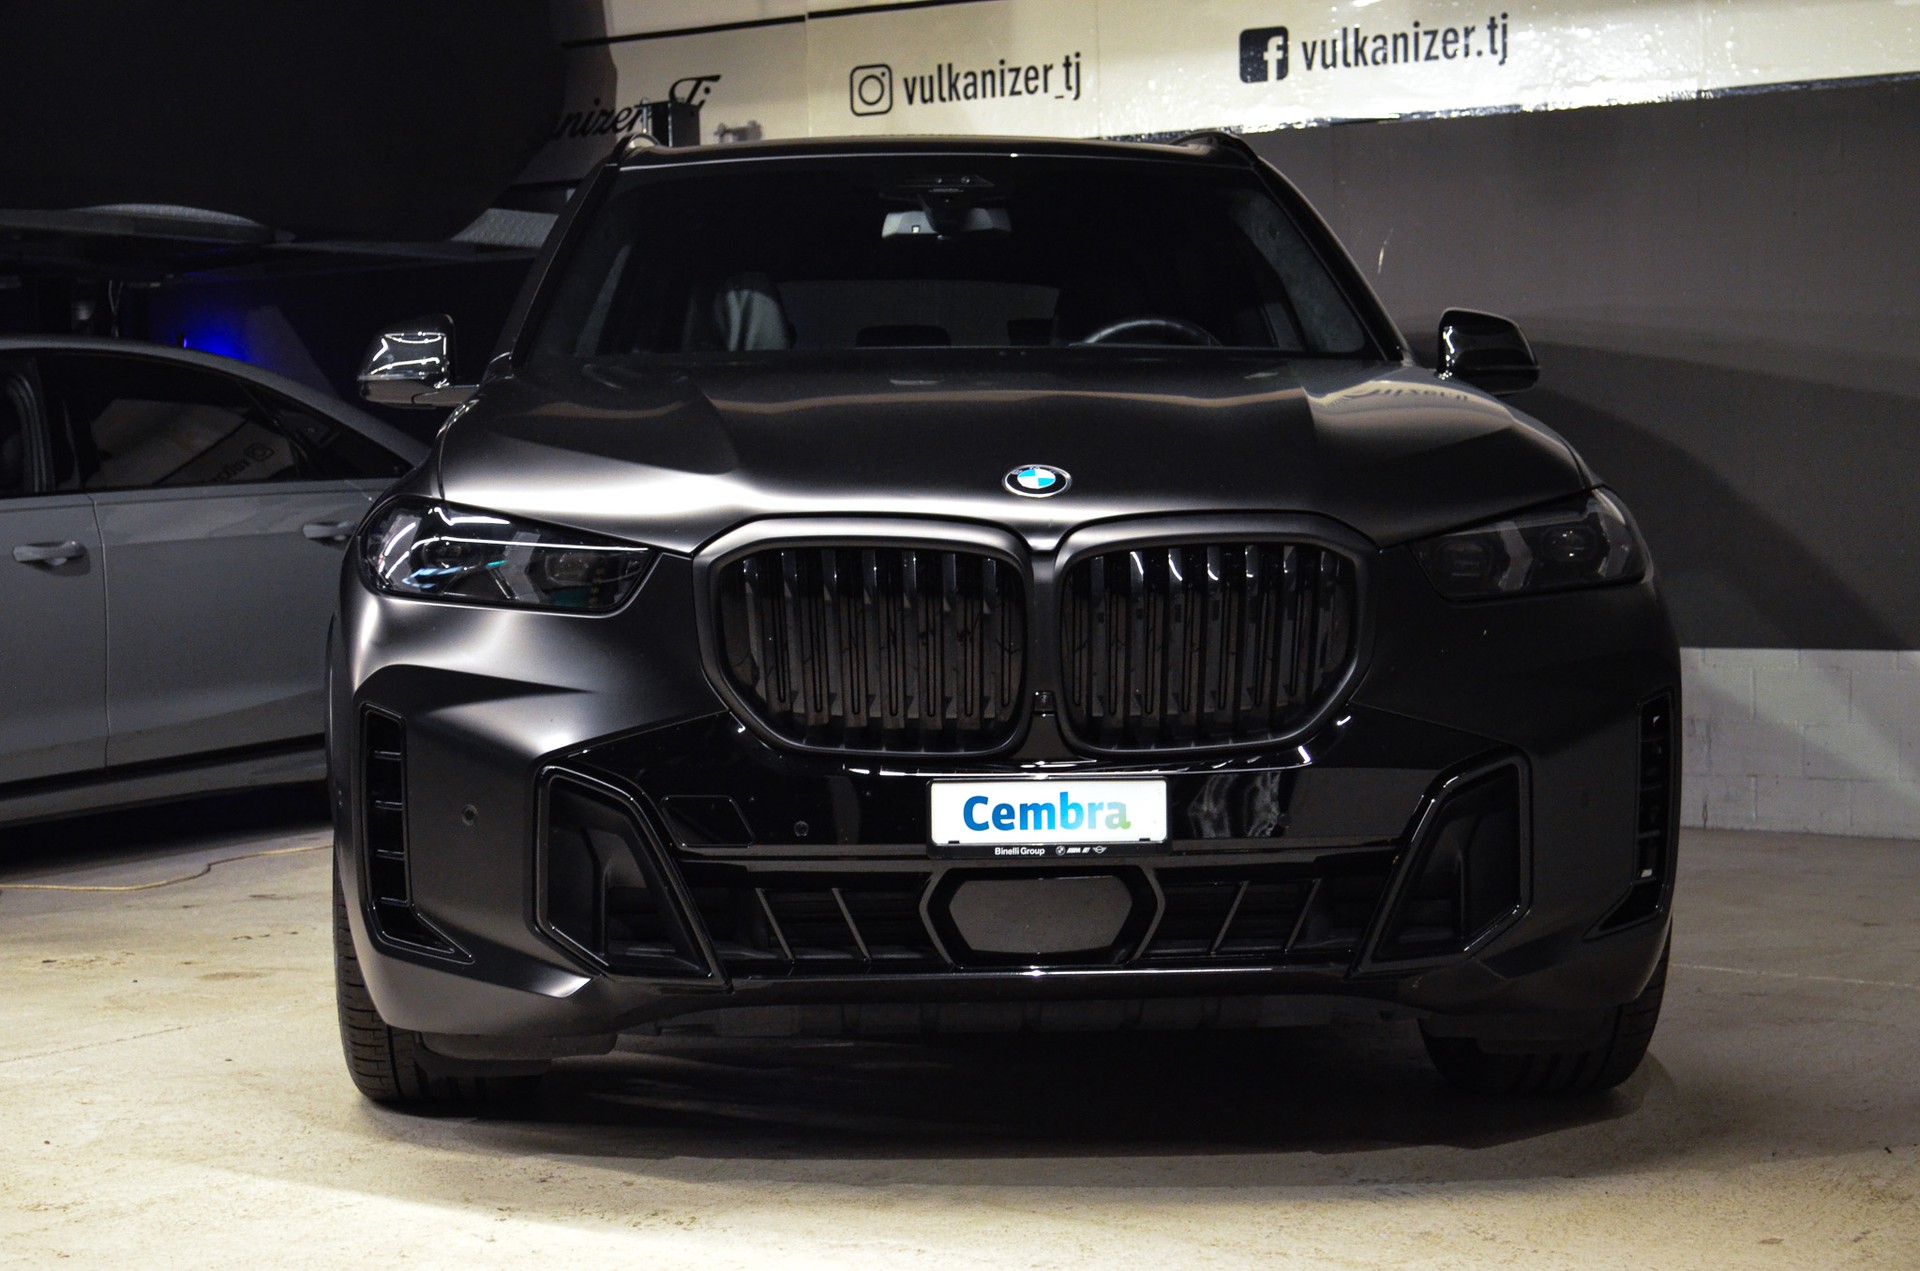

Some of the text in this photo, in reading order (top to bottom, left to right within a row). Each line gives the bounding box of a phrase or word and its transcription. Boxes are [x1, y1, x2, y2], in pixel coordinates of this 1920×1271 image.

[1302, 12, 1509, 71] vulkanizer.tj
[903, 51, 1081, 105] vulkanizer_tj
[963, 791, 1131, 832] Cembra
[994, 846, 1045, 857] Binelli Group
